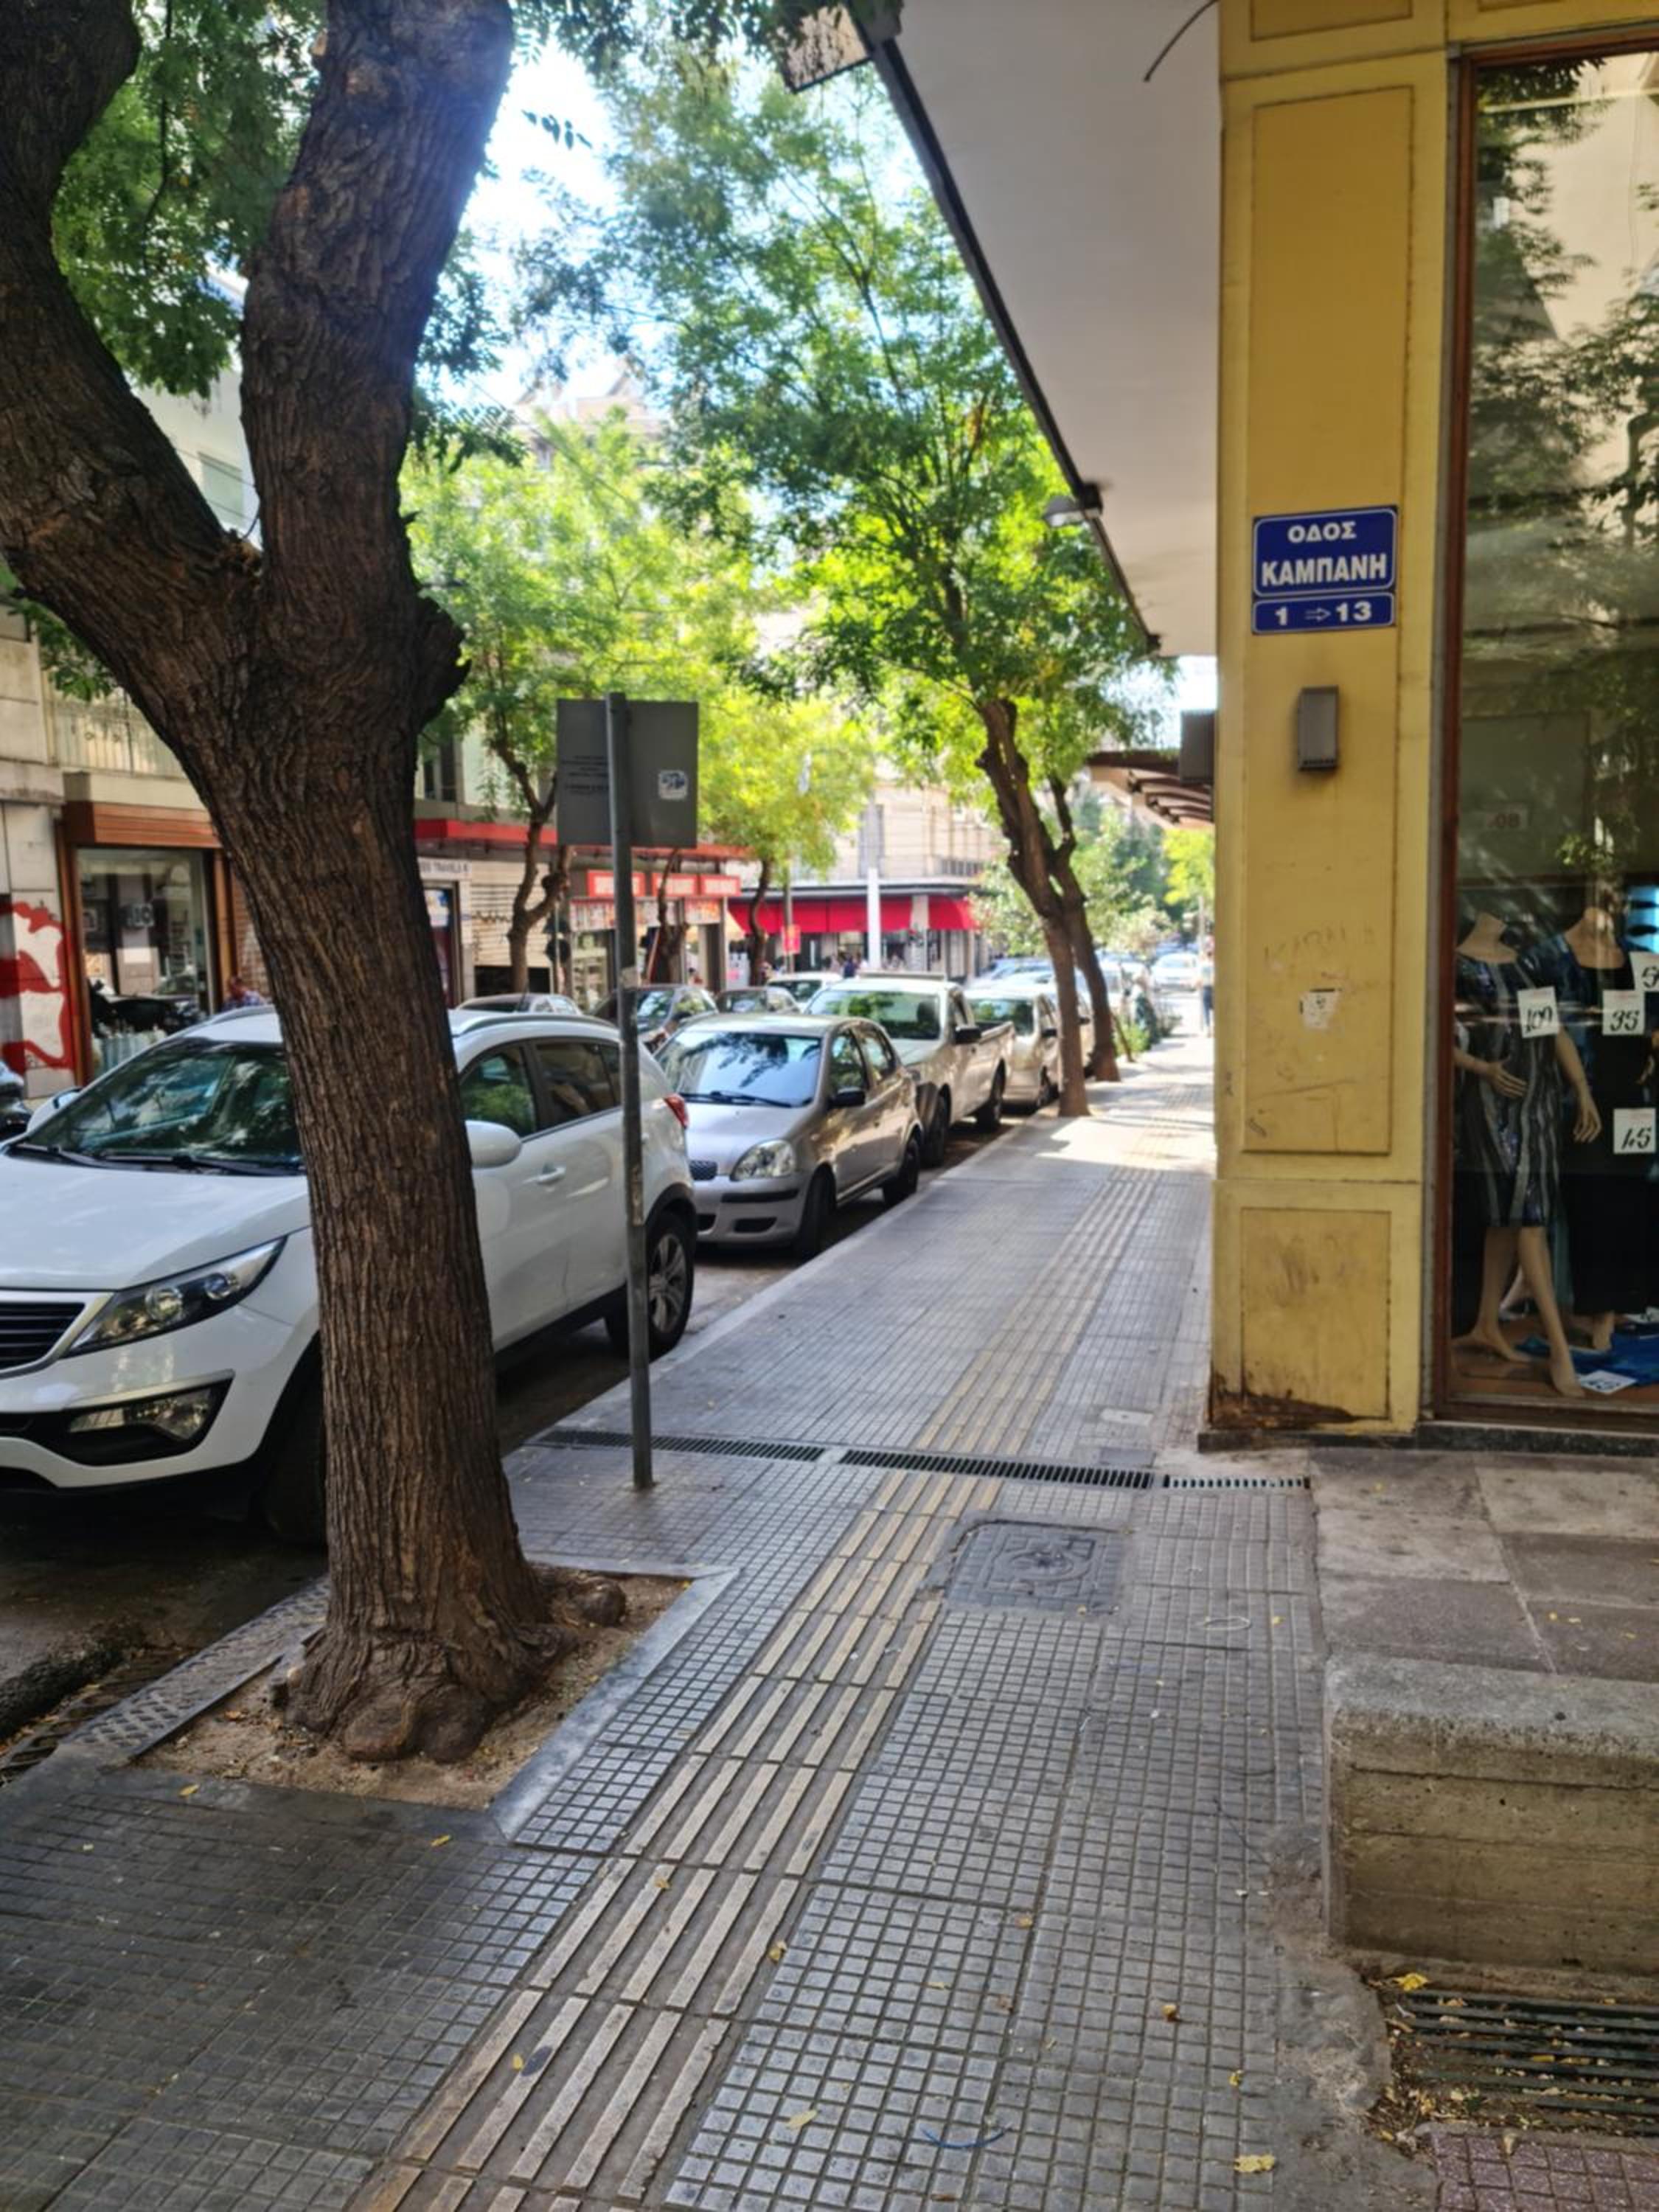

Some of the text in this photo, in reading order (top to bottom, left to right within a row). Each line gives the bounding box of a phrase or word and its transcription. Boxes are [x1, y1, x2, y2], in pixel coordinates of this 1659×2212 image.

[1287, 521, 1356, 543] ΟΔΟΣ
[1262, 554, 1386, 586] ΚΑΜΠΑΝΗ
[1275, 601, 1371, 625] 1 13
